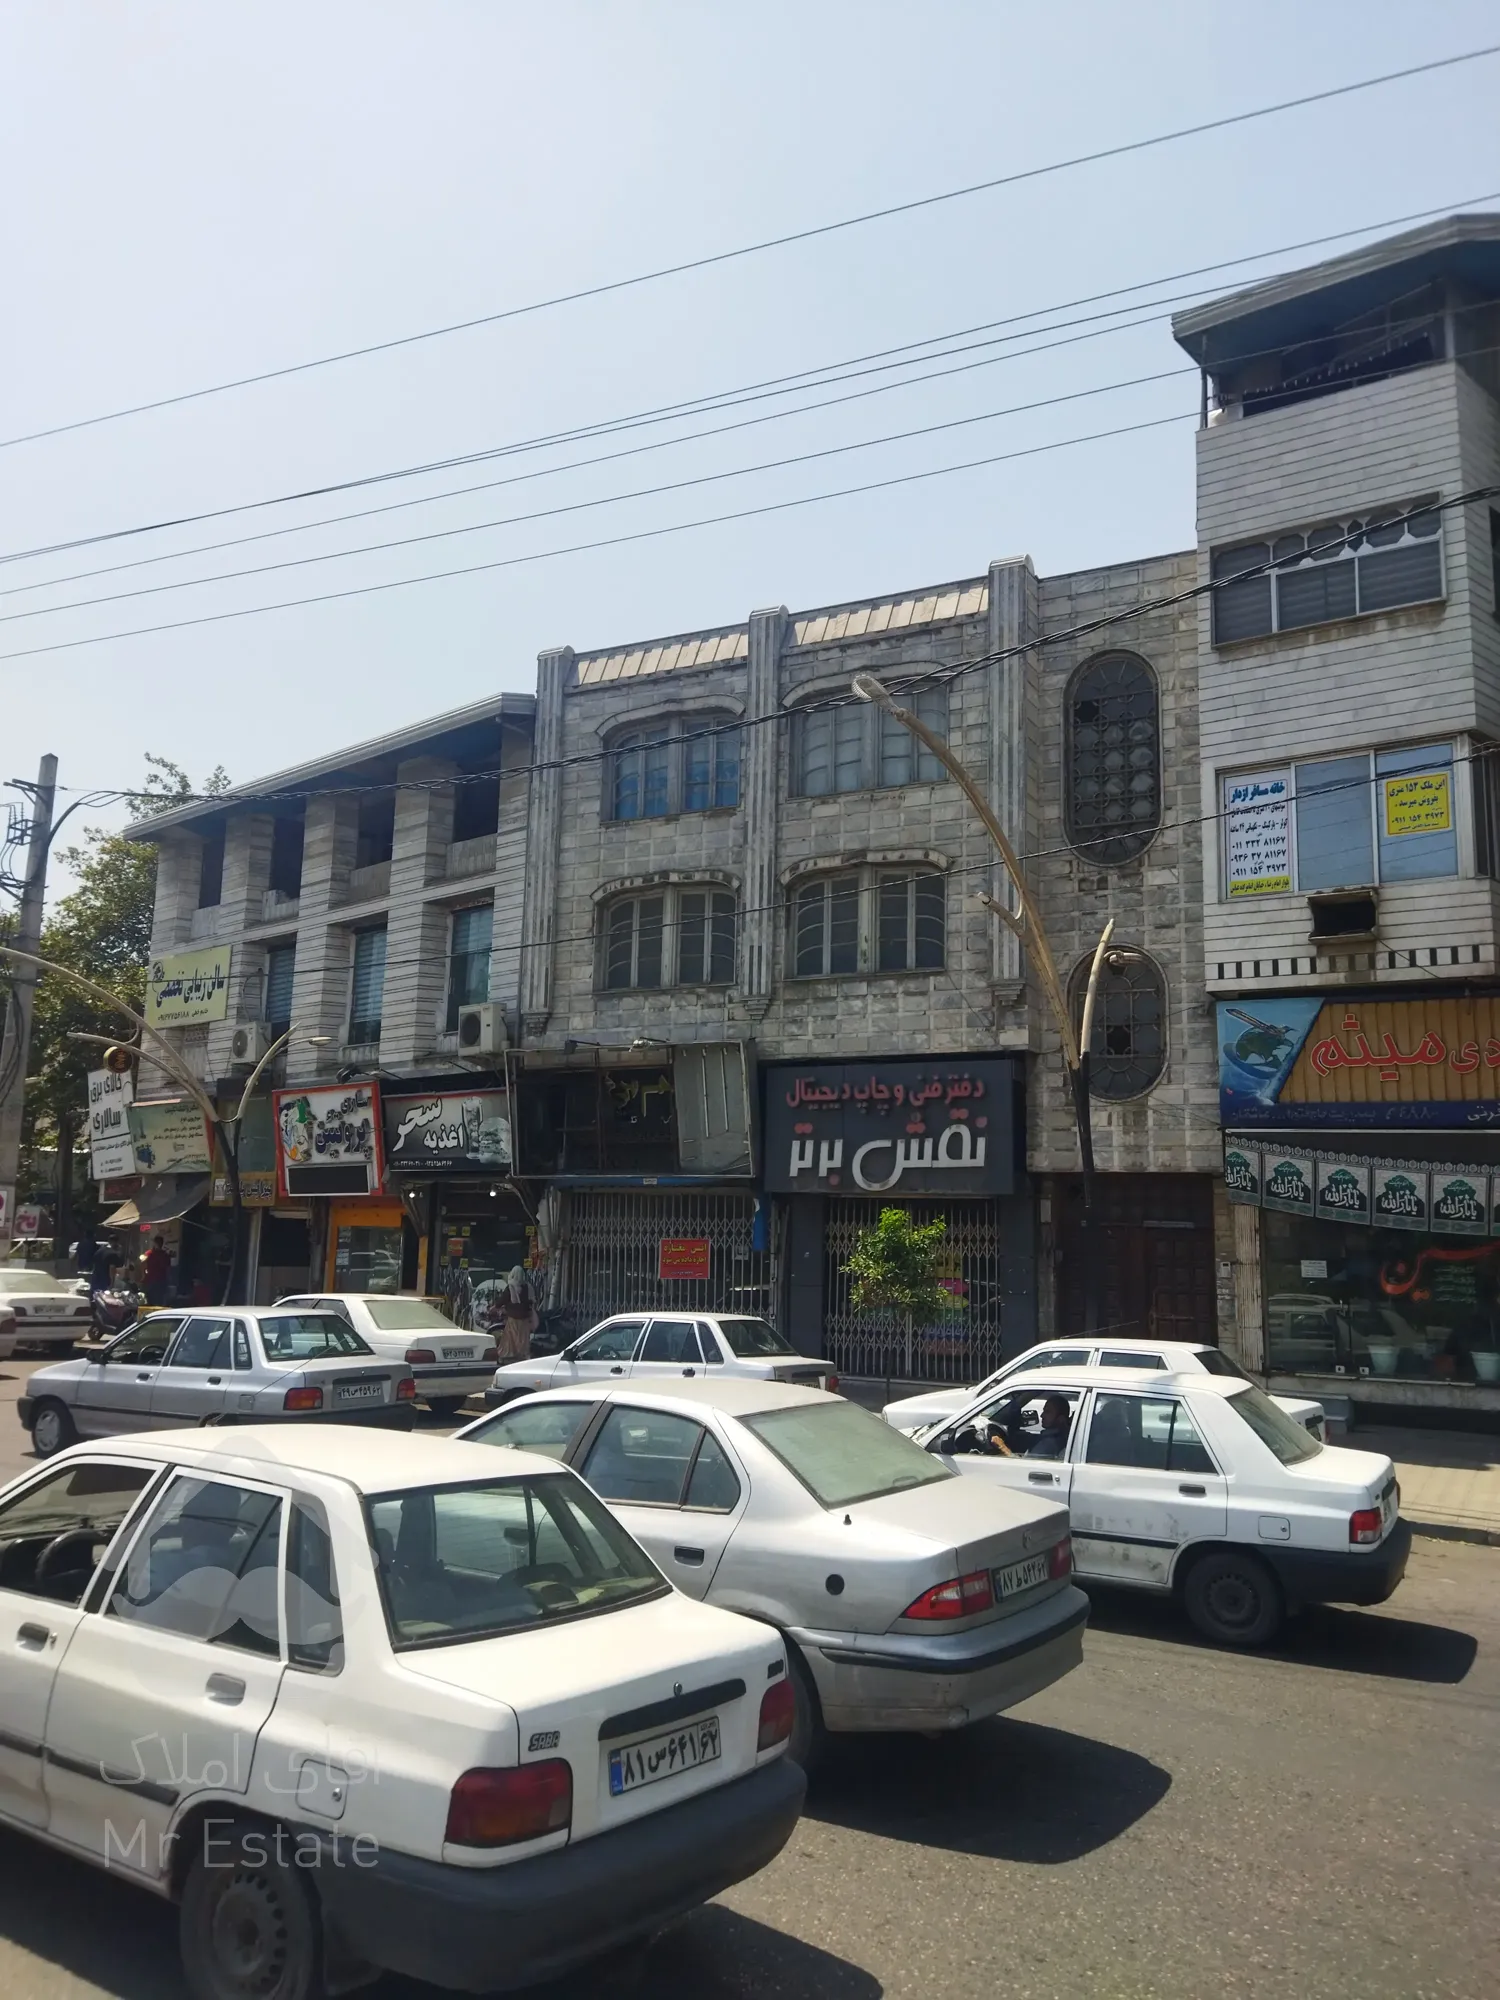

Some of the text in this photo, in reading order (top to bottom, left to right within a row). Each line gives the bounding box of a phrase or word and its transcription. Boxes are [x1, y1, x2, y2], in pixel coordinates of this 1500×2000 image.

[1270, 781, 1285, 794] خانه
[1421, 780, 1433, 790] ملک
[1435, 778, 1445, 790] این
[1249, 784, 1269, 801] مسافر
[1389, 785, 1404, 797] متری
[1409, 813, 1421, 822] ۱۵۴
[1232, 841, 1242, 849] ۰۱۱
[1263, 836, 1286, 846] ۸۱۱۶۷
[1231, 849, 1286, 862] ۰۹۳۶ ۳۷ ۸۱۱۶۷
[1232, 868, 1246, 876] ۰۹۱۱
[1250, 865, 1263, 875] ۱۵۴
[786, 1074, 985, 1115] دفتر فنی و چاپ دیجیتال
[93, 1108, 121, 1134] سالاری
[393, 1097, 442, 1151] سحر
[423, 1123, 464, 1155] اغذیه
[852, 1108, 988, 1191] نقش
[529, 1731, 560, 1752] SABA
